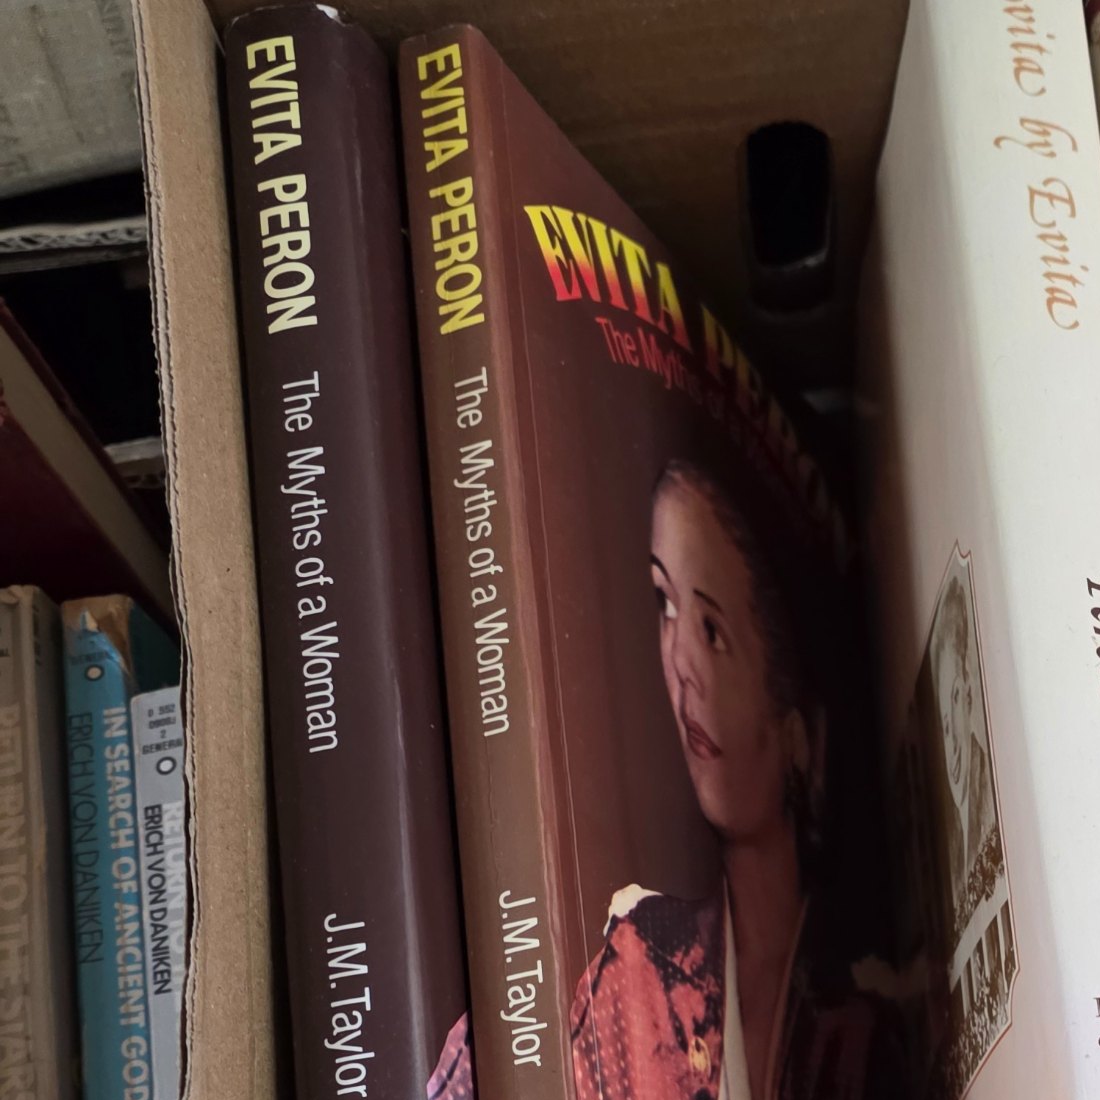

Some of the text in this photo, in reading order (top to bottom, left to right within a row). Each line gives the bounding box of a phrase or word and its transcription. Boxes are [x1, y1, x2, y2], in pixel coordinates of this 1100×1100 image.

[994, 0, 1091, 331] vita by Evita
[524, 204, 693, 351] EVITA
[246, 35, 341, 754] EVITA PERON The Myths of a Woman
[416, 42, 510, 738] EVITA PERON The Myths of a Woman
[595, 316, 638, 368] The
[67, 711, 94, 778] ERICH
[103, 707, 128, 730] IN
[70, 786, 99, 846] VON
[104, 741, 135, 850] SEARCH
[111, 856, 138, 895] OF
[144, 804, 172, 995] ERICH VON DANIKEN
[114, 902, 145, 1029] ANCIENT
